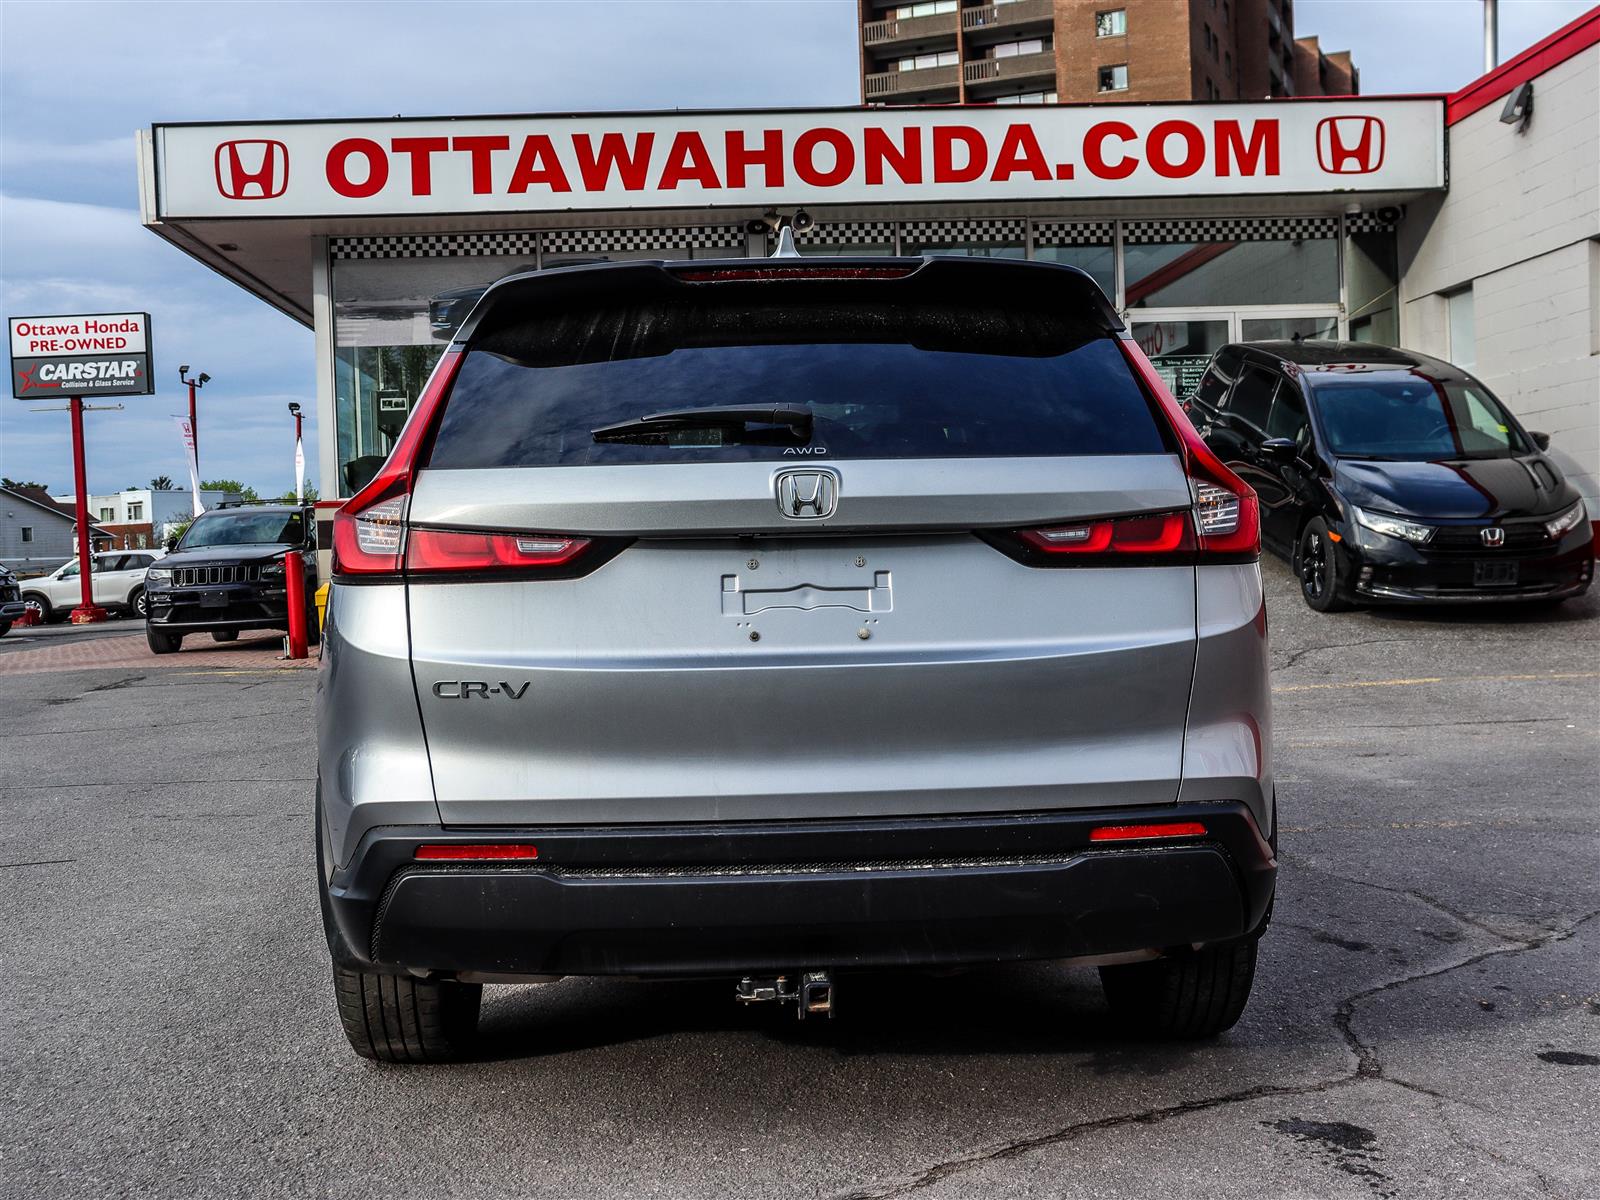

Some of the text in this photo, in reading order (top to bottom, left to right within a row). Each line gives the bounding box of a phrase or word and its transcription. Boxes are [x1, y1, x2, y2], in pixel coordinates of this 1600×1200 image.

[326, 119, 1280, 199] OTTAWAHONDA.COM
[16, 319, 139, 337] Ottawa Honda
[30, 337, 127, 352] PRE-OWNED
[783, 447, 827, 455] AWD
[432, 680, 531, 700] CR-V
